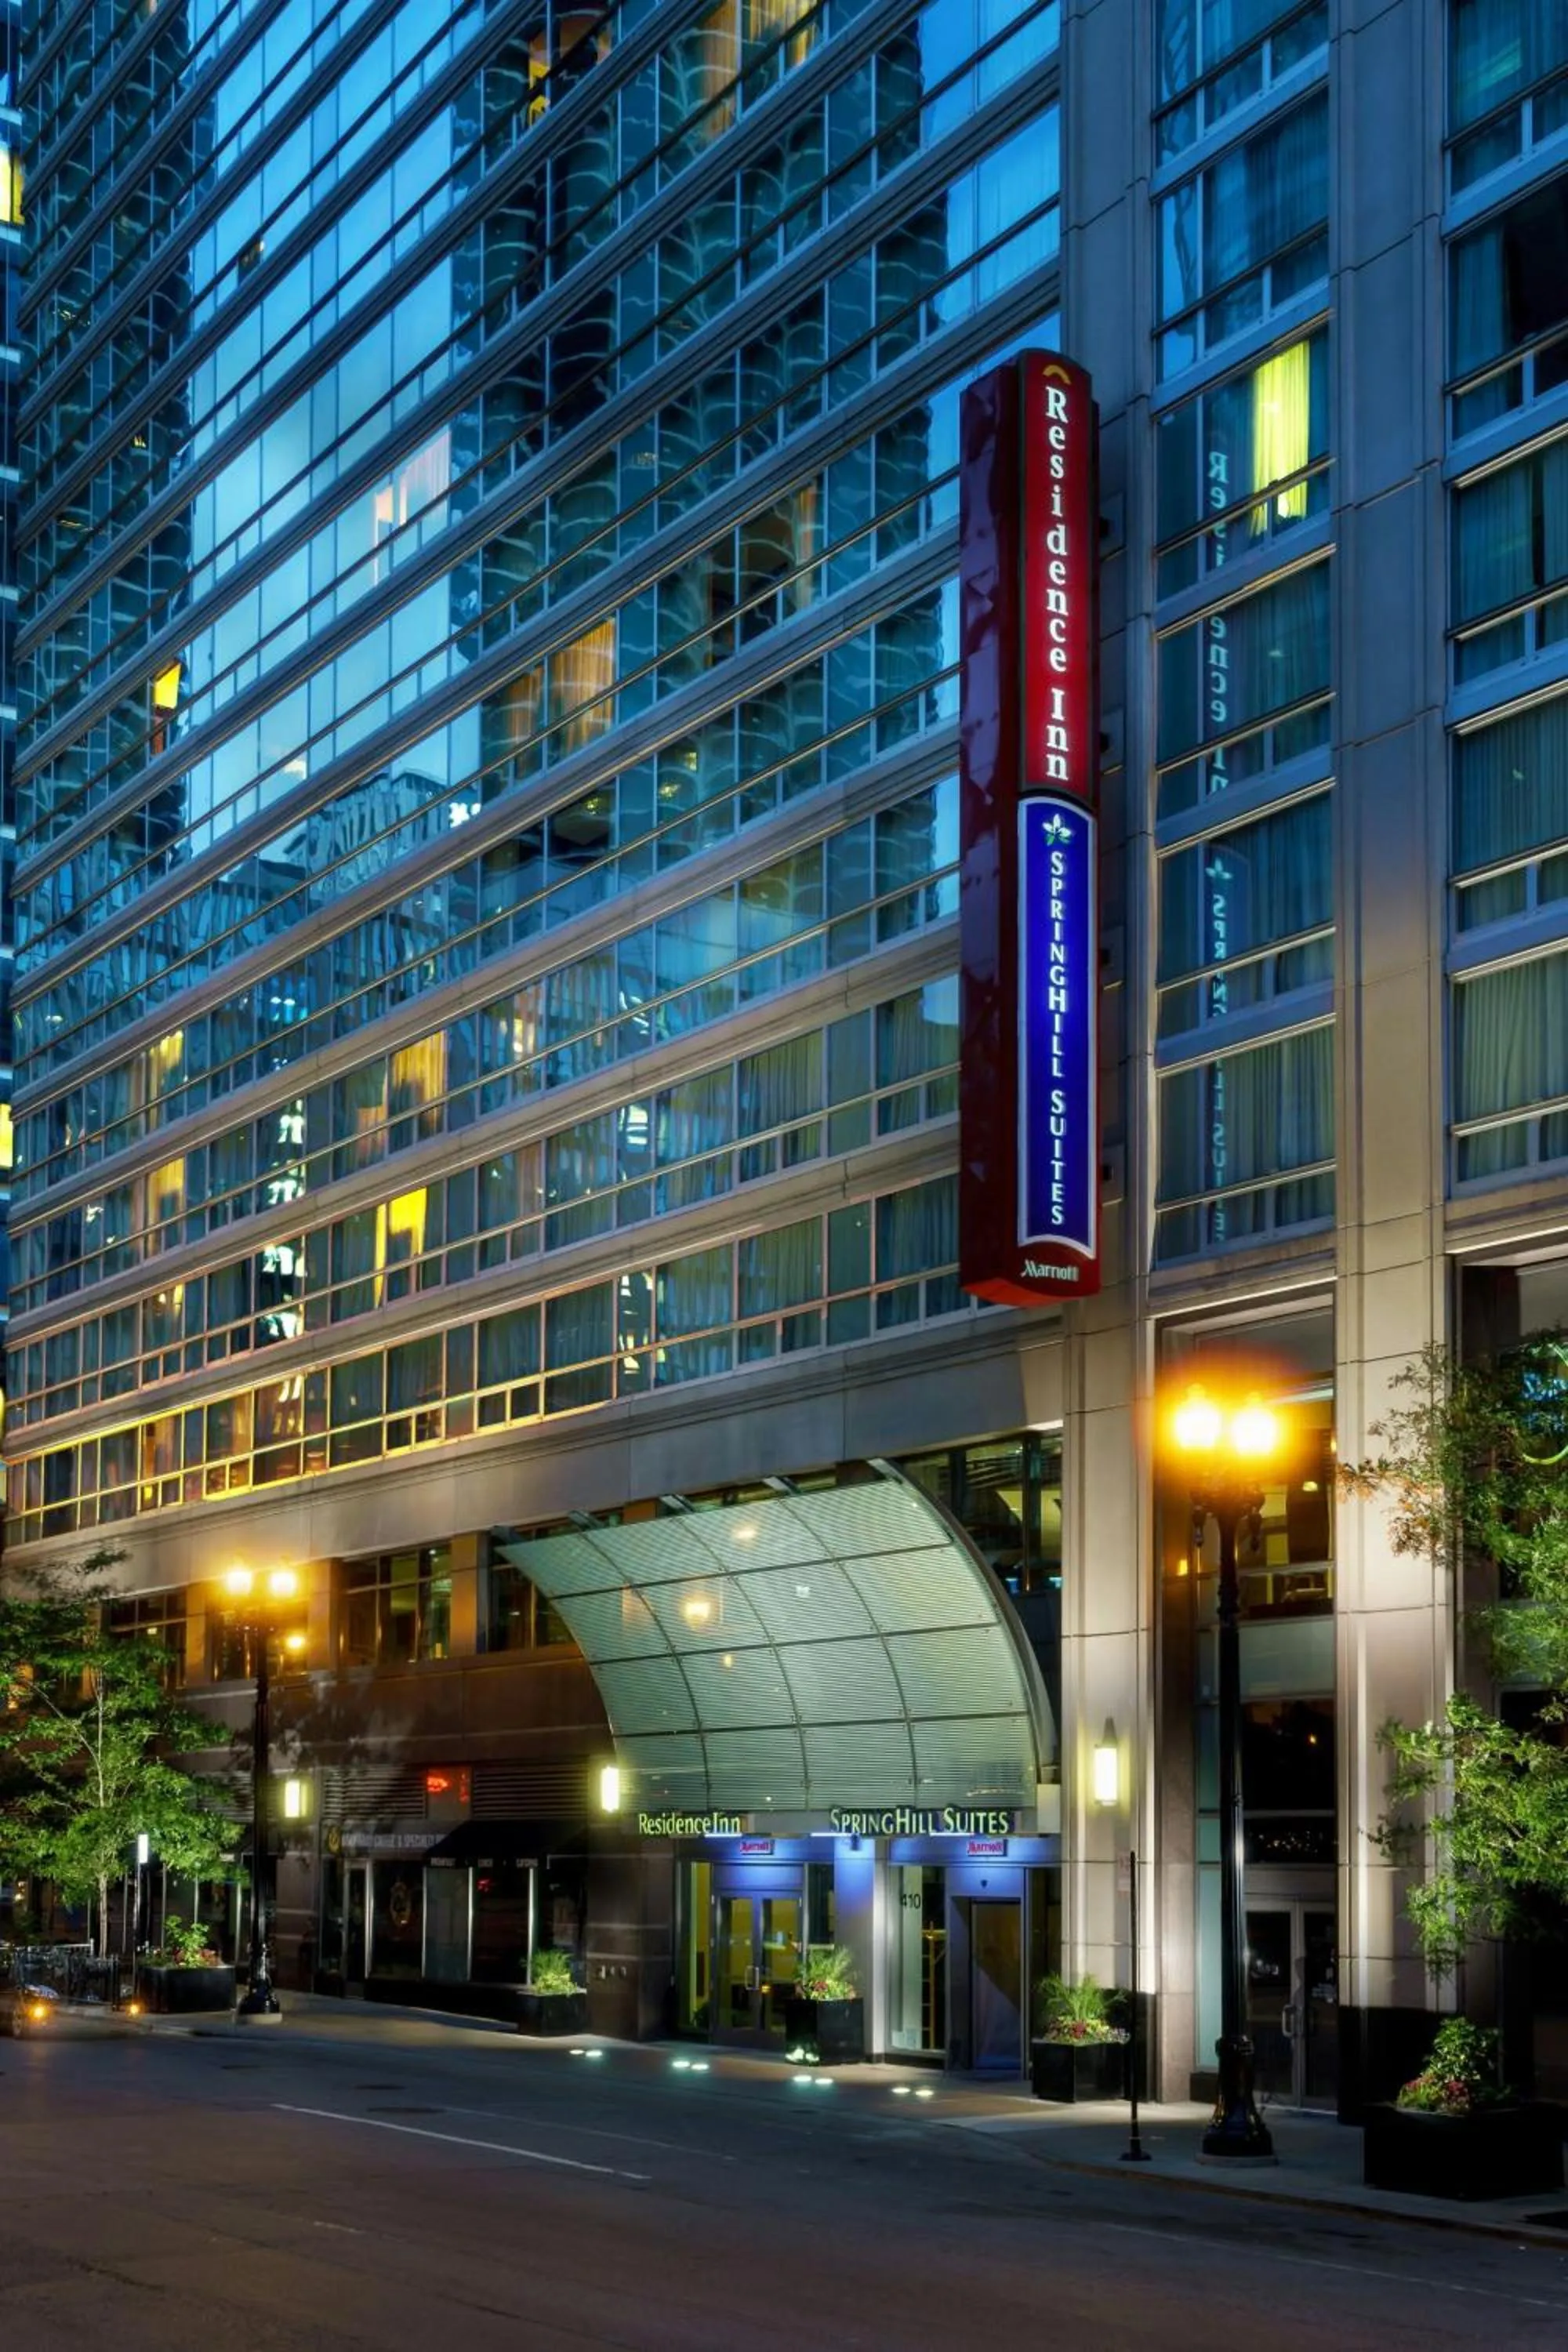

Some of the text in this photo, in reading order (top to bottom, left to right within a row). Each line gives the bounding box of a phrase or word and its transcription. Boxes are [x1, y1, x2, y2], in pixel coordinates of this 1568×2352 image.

[1045, 387, 1069, 781] Residence Inn
[1048, 851, 1067, 1225] SPRINGHILL SUITES
[1020, 1258, 1080, 1282] Marriott
[639, 1811, 741, 1835] Residence Inn
[943, 1806, 1009, 1835] SUITES
[900, 1893, 921, 1909] 410
